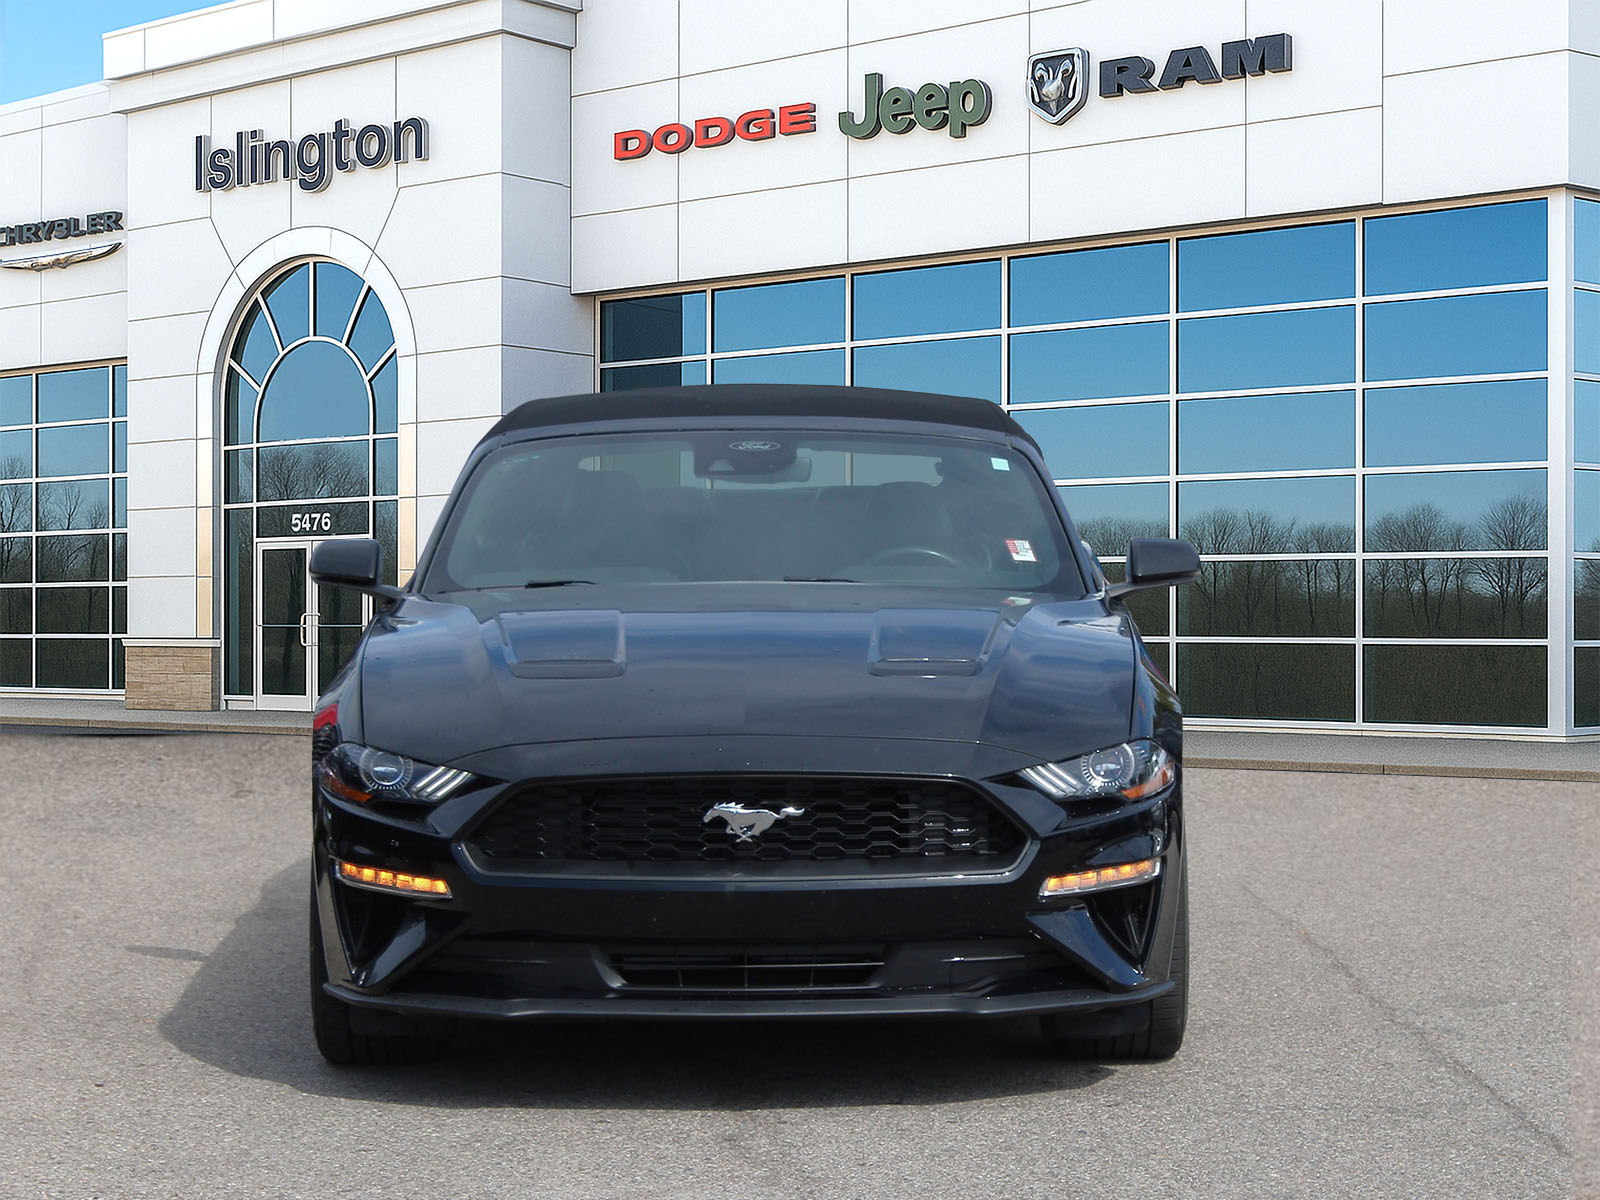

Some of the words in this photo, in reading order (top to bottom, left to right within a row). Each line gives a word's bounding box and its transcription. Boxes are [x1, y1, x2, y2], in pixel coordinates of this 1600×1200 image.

[1100, 33, 1293, 98] RAM
[614, 102, 817, 160] DODGE
[839, 73, 992, 139] Jeep
[195, 116, 429, 192] Islington
[738, 441, 772, 451] Ford
[291, 512, 331, 532] 5476
